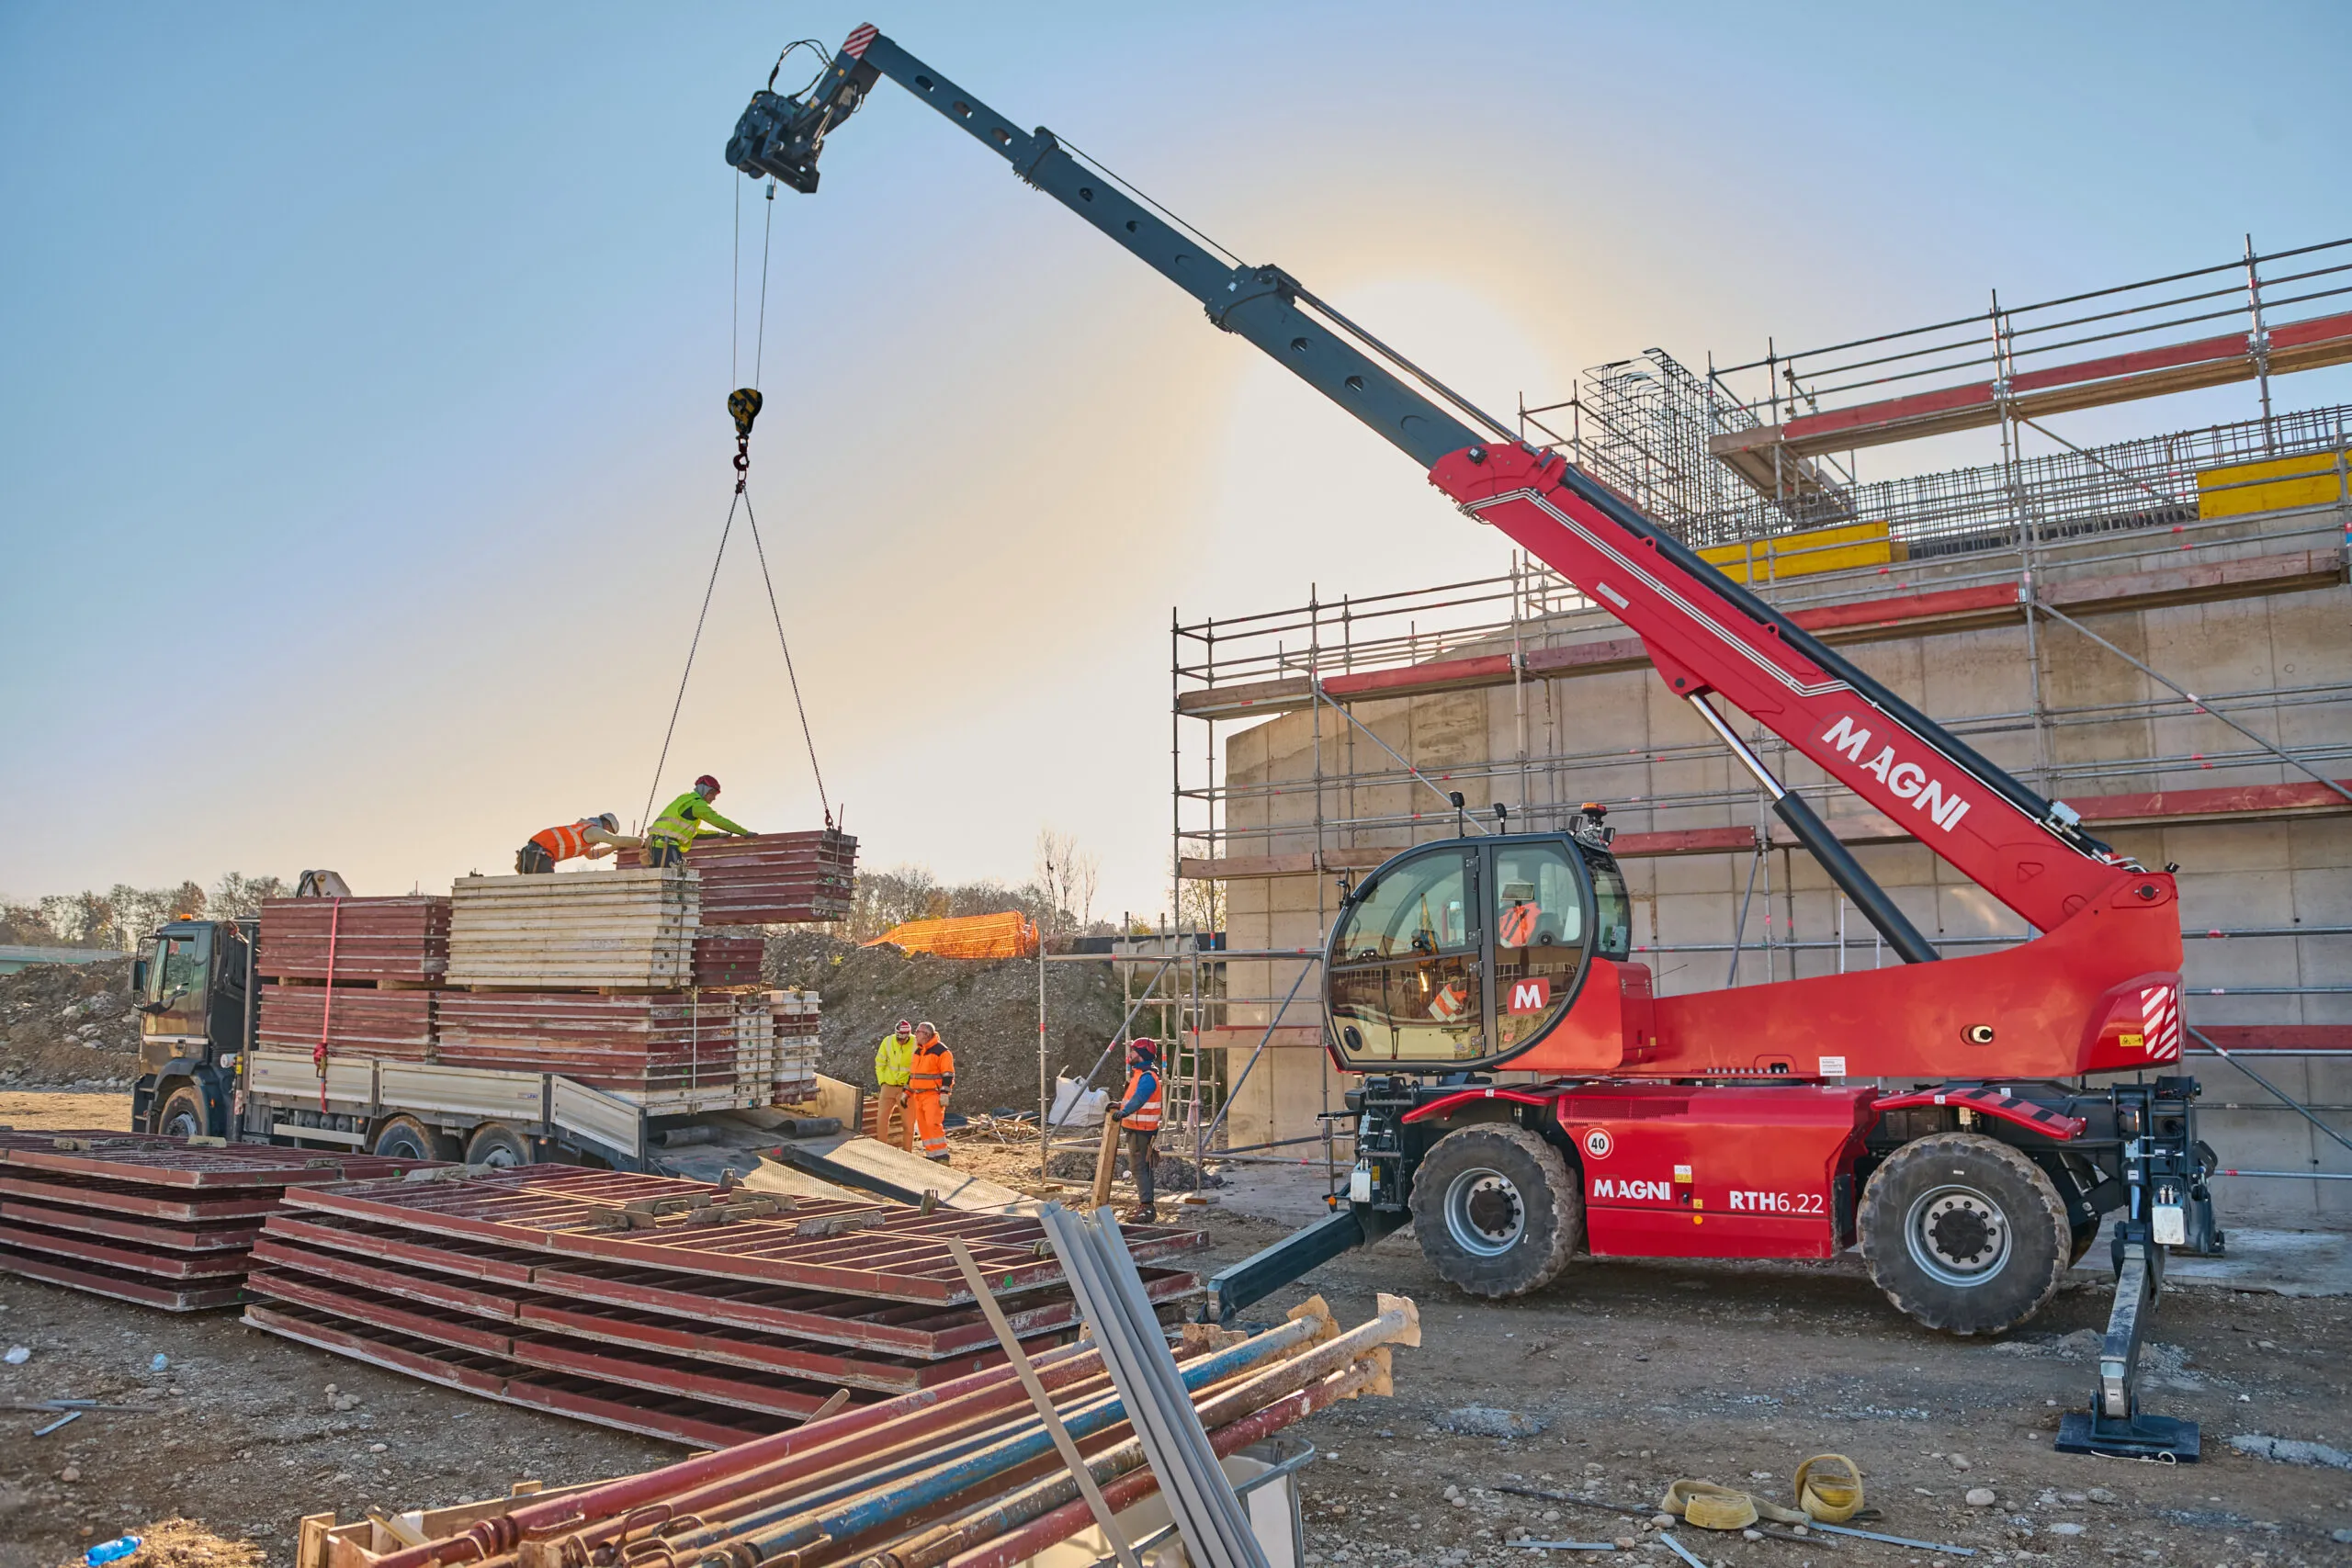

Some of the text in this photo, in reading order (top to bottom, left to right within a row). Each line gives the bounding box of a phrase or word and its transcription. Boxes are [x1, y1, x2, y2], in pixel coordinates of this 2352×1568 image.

[1821, 716, 1971, 832] MAGNI
[1514, 985, 1543, 1009] M
[1590, 1138, 1605, 1150] 40
[1593, 1179, 1671, 1201] MAGNI
[1729, 1190, 1825, 1213] RTH6.22
